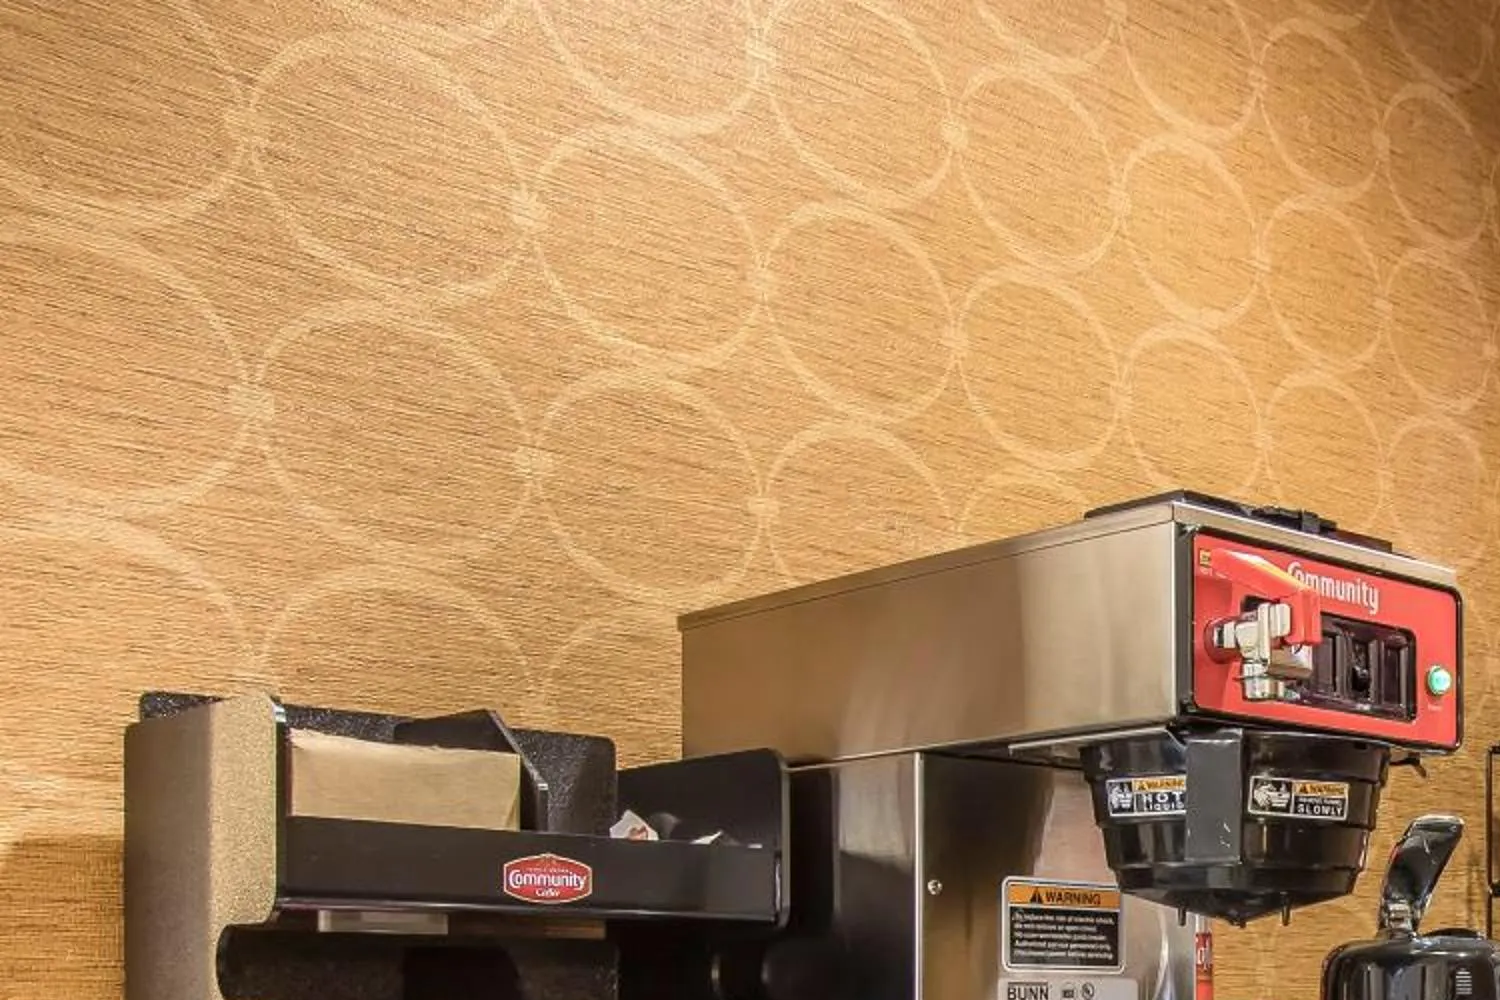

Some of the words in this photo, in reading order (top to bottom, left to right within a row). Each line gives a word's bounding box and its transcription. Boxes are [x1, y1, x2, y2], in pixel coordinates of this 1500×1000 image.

[508, 869, 587, 891] Community
[1045, 891, 1101, 905] WARNING
[1007, 986, 1049, 1000] BUNN
